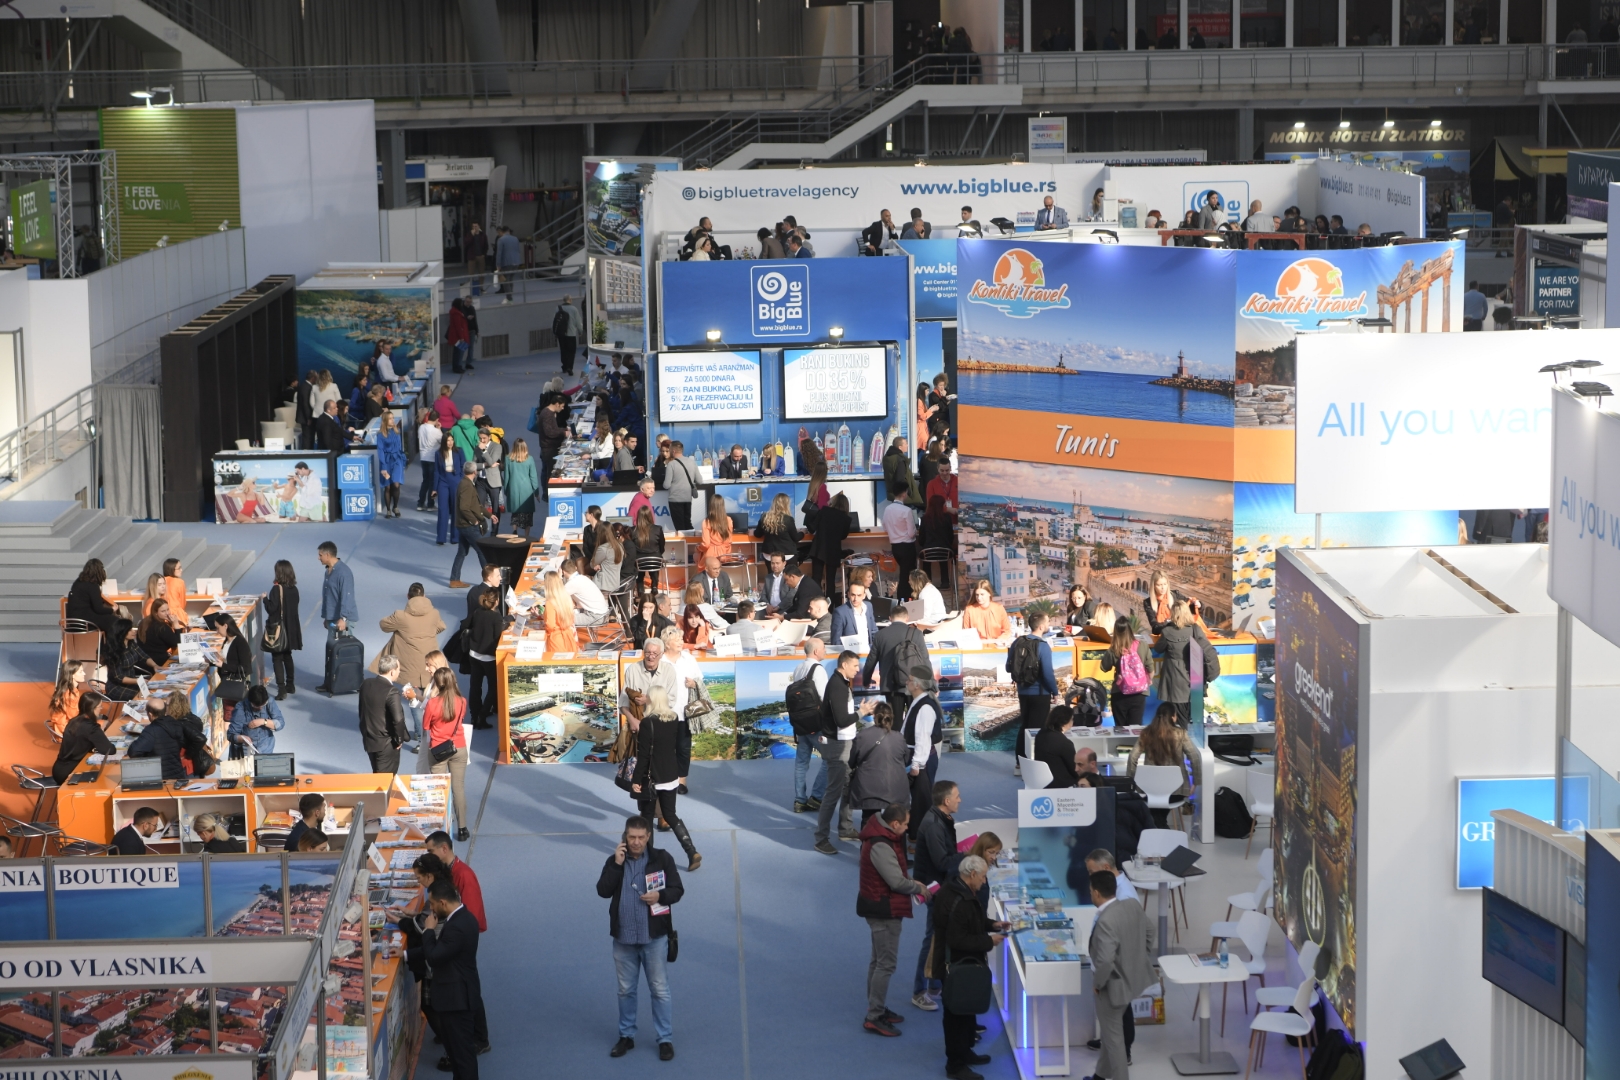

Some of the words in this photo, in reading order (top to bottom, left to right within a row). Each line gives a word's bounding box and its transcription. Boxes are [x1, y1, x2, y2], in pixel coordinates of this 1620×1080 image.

[1270, 131, 1325, 144] MONIX
[1330, 130, 1385, 143] HOTELI
[1389, 129, 1466, 142] ZLATIBOR
[132, 186, 159, 198] FEEL
[699, 185, 860, 202] bigbluetravelagency
[901, 178, 1057, 197] www.bigblue.rs
[23, 191, 38, 216] FEEL
[1539, 276, 1551, 285] WE
[1552, 276, 1566, 285] ARE
[785, 281, 803, 319] Blue
[1022, 283, 1067, 303] Travel
[1316, 292, 1367, 314] Travel
[1539, 288, 1572, 298] PARTNER
[758, 303, 786, 324] Big
[1539, 300, 1554, 309] FOR
[1555, 300, 1574, 308] ITALY
[665, 364, 704, 373] REZERVIŠITE
[705, 363, 717, 372] VAŠ
[719, 363, 755, 372] ARANŽMAN
[800, 354, 827, 370] RANI
[829, 353, 870, 369] BUKING
[806, 370, 826, 390] DO
[1317, 402, 1365, 438] All
[1379, 409, 1454, 445] you
[1056, 424, 1120, 458] Tunis
[216, 462, 241, 473] KHG
[1560, 476, 1577, 522] All
[1579, 496, 1606, 541] you
[1462, 822, 1495, 842] GR
[0, 871, 42, 887] NIA
[59, 867, 178, 887] BOUTIQUE
[0, 961, 17, 979] O
[24, 960, 62, 979] OD
[69, 956, 206, 977] VLASNIKA
